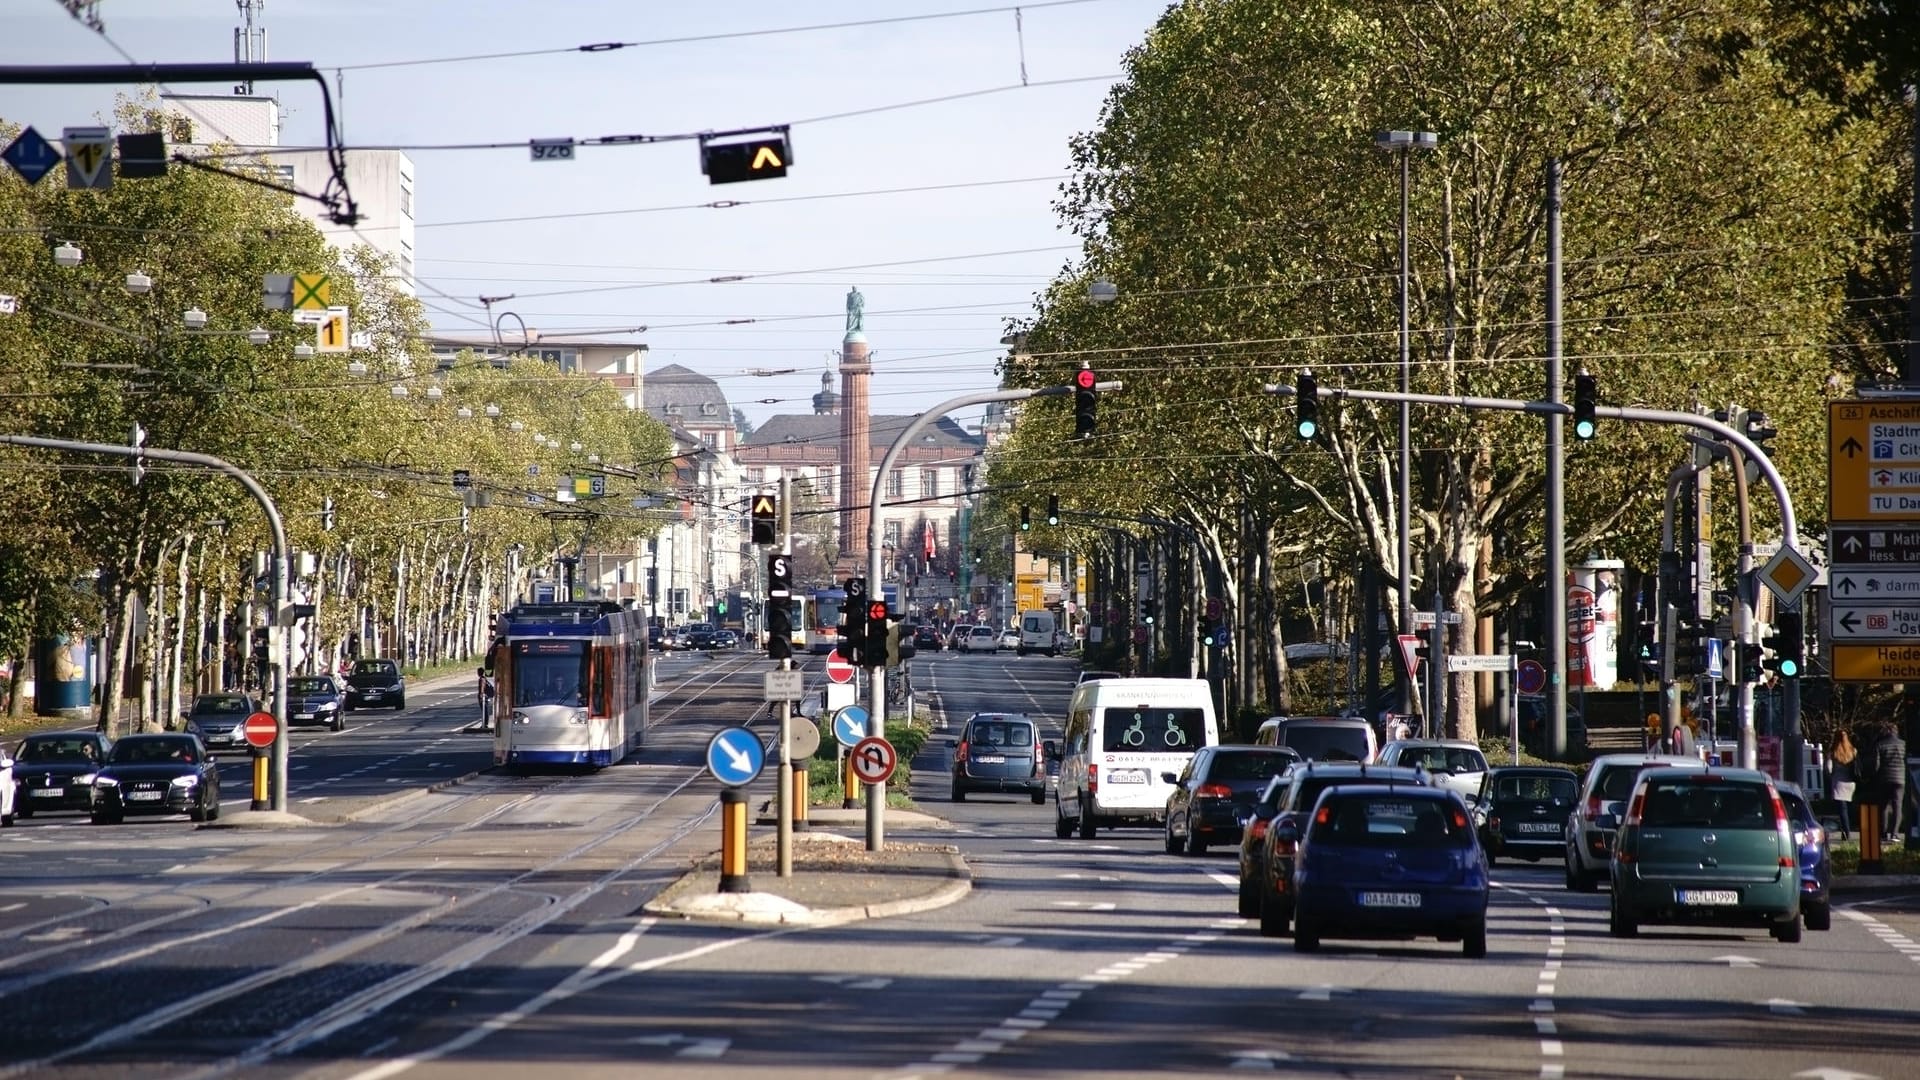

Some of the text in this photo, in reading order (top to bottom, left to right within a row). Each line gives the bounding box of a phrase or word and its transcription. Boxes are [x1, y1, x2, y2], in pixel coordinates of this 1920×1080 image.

[1846, 409, 1857, 417] 26
[1874, 497, 1892, 510] TU
[774, 559, 786, 576] S
[852, 582, 860, 595] S
